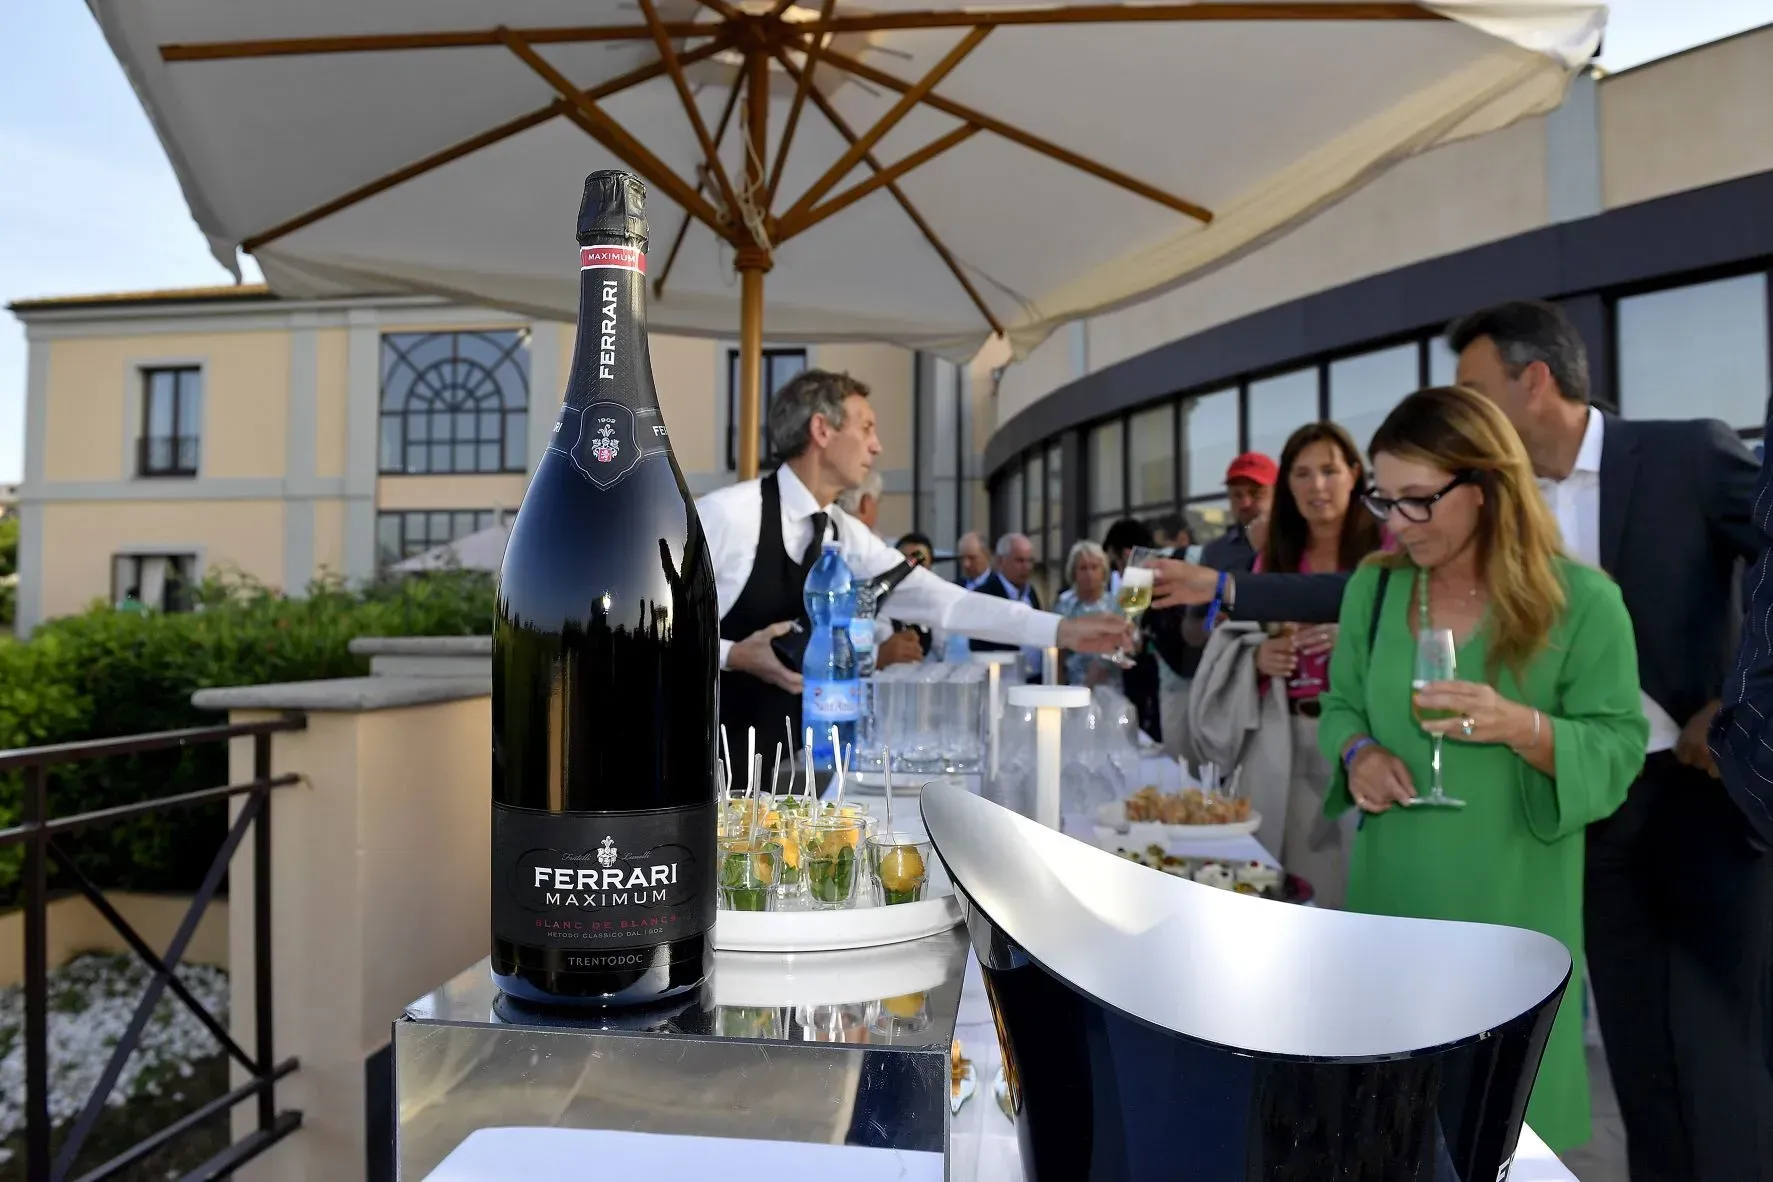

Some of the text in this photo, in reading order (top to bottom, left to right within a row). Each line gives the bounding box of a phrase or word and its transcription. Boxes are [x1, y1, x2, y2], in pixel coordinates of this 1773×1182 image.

[588, 252, 636, 262] MAXIMUM
[600, 280, 618, 380] FERRARI
[534, 863, 678, 890] FERRARI
[546, 889, 667, 907] MAXIMUM
[535, 914, 679, 930] BLANC DE BLANCS
[582, 931, 624, 939] CLASSICO
[568, 954, 643, 966] TRENTODOC
